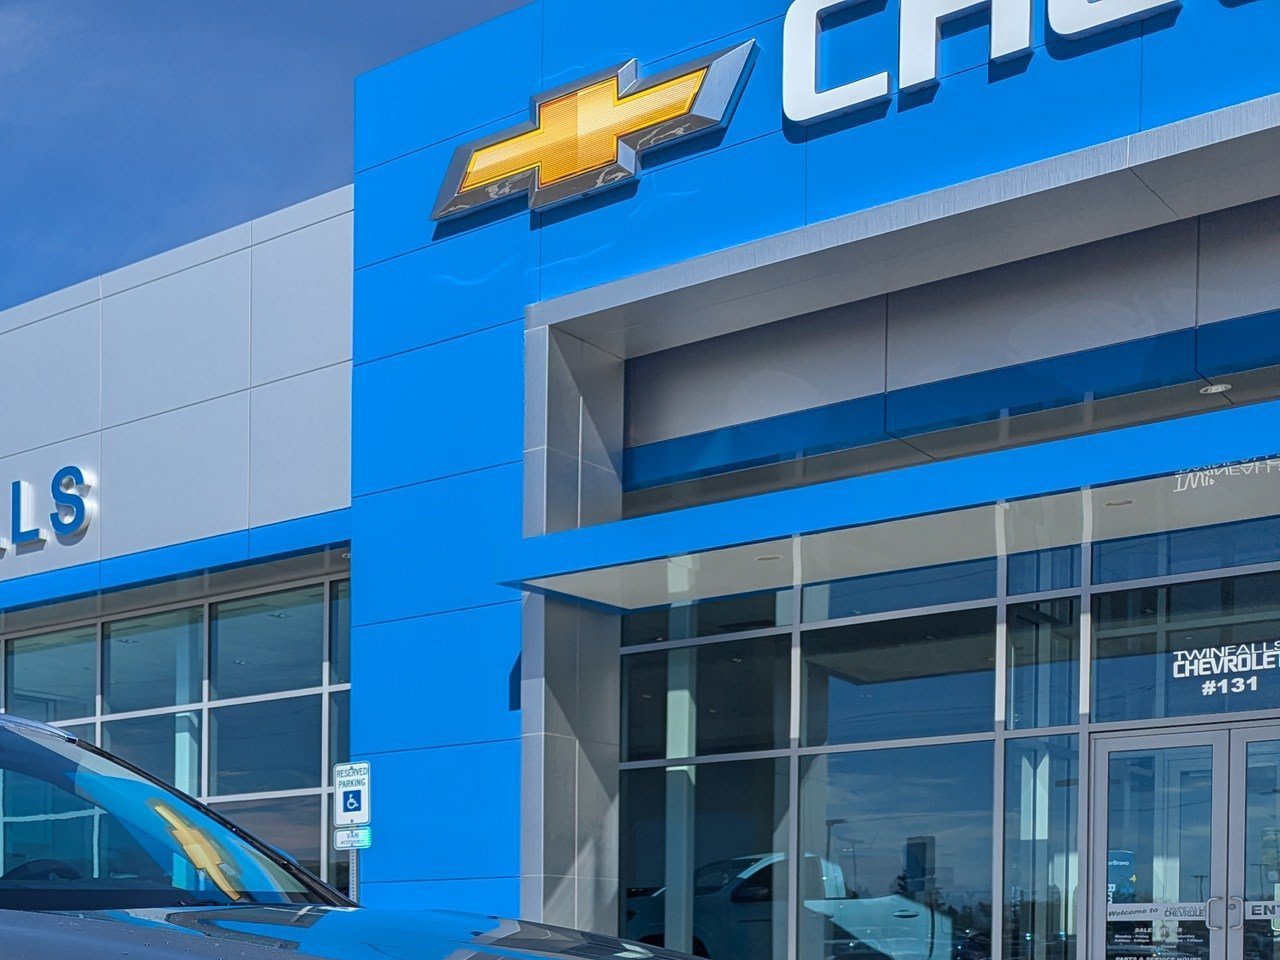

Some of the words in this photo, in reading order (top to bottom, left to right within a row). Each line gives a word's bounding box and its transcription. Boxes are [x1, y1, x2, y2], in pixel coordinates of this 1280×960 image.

[1201, 676, 1257, 696] #131
[336, 767, 368, 778] RESERVED
[338, 778, 366, 789] PARKING
[1109, 908, 1147, 917] Welcome
[1251, 905, 1280, 916] EN
